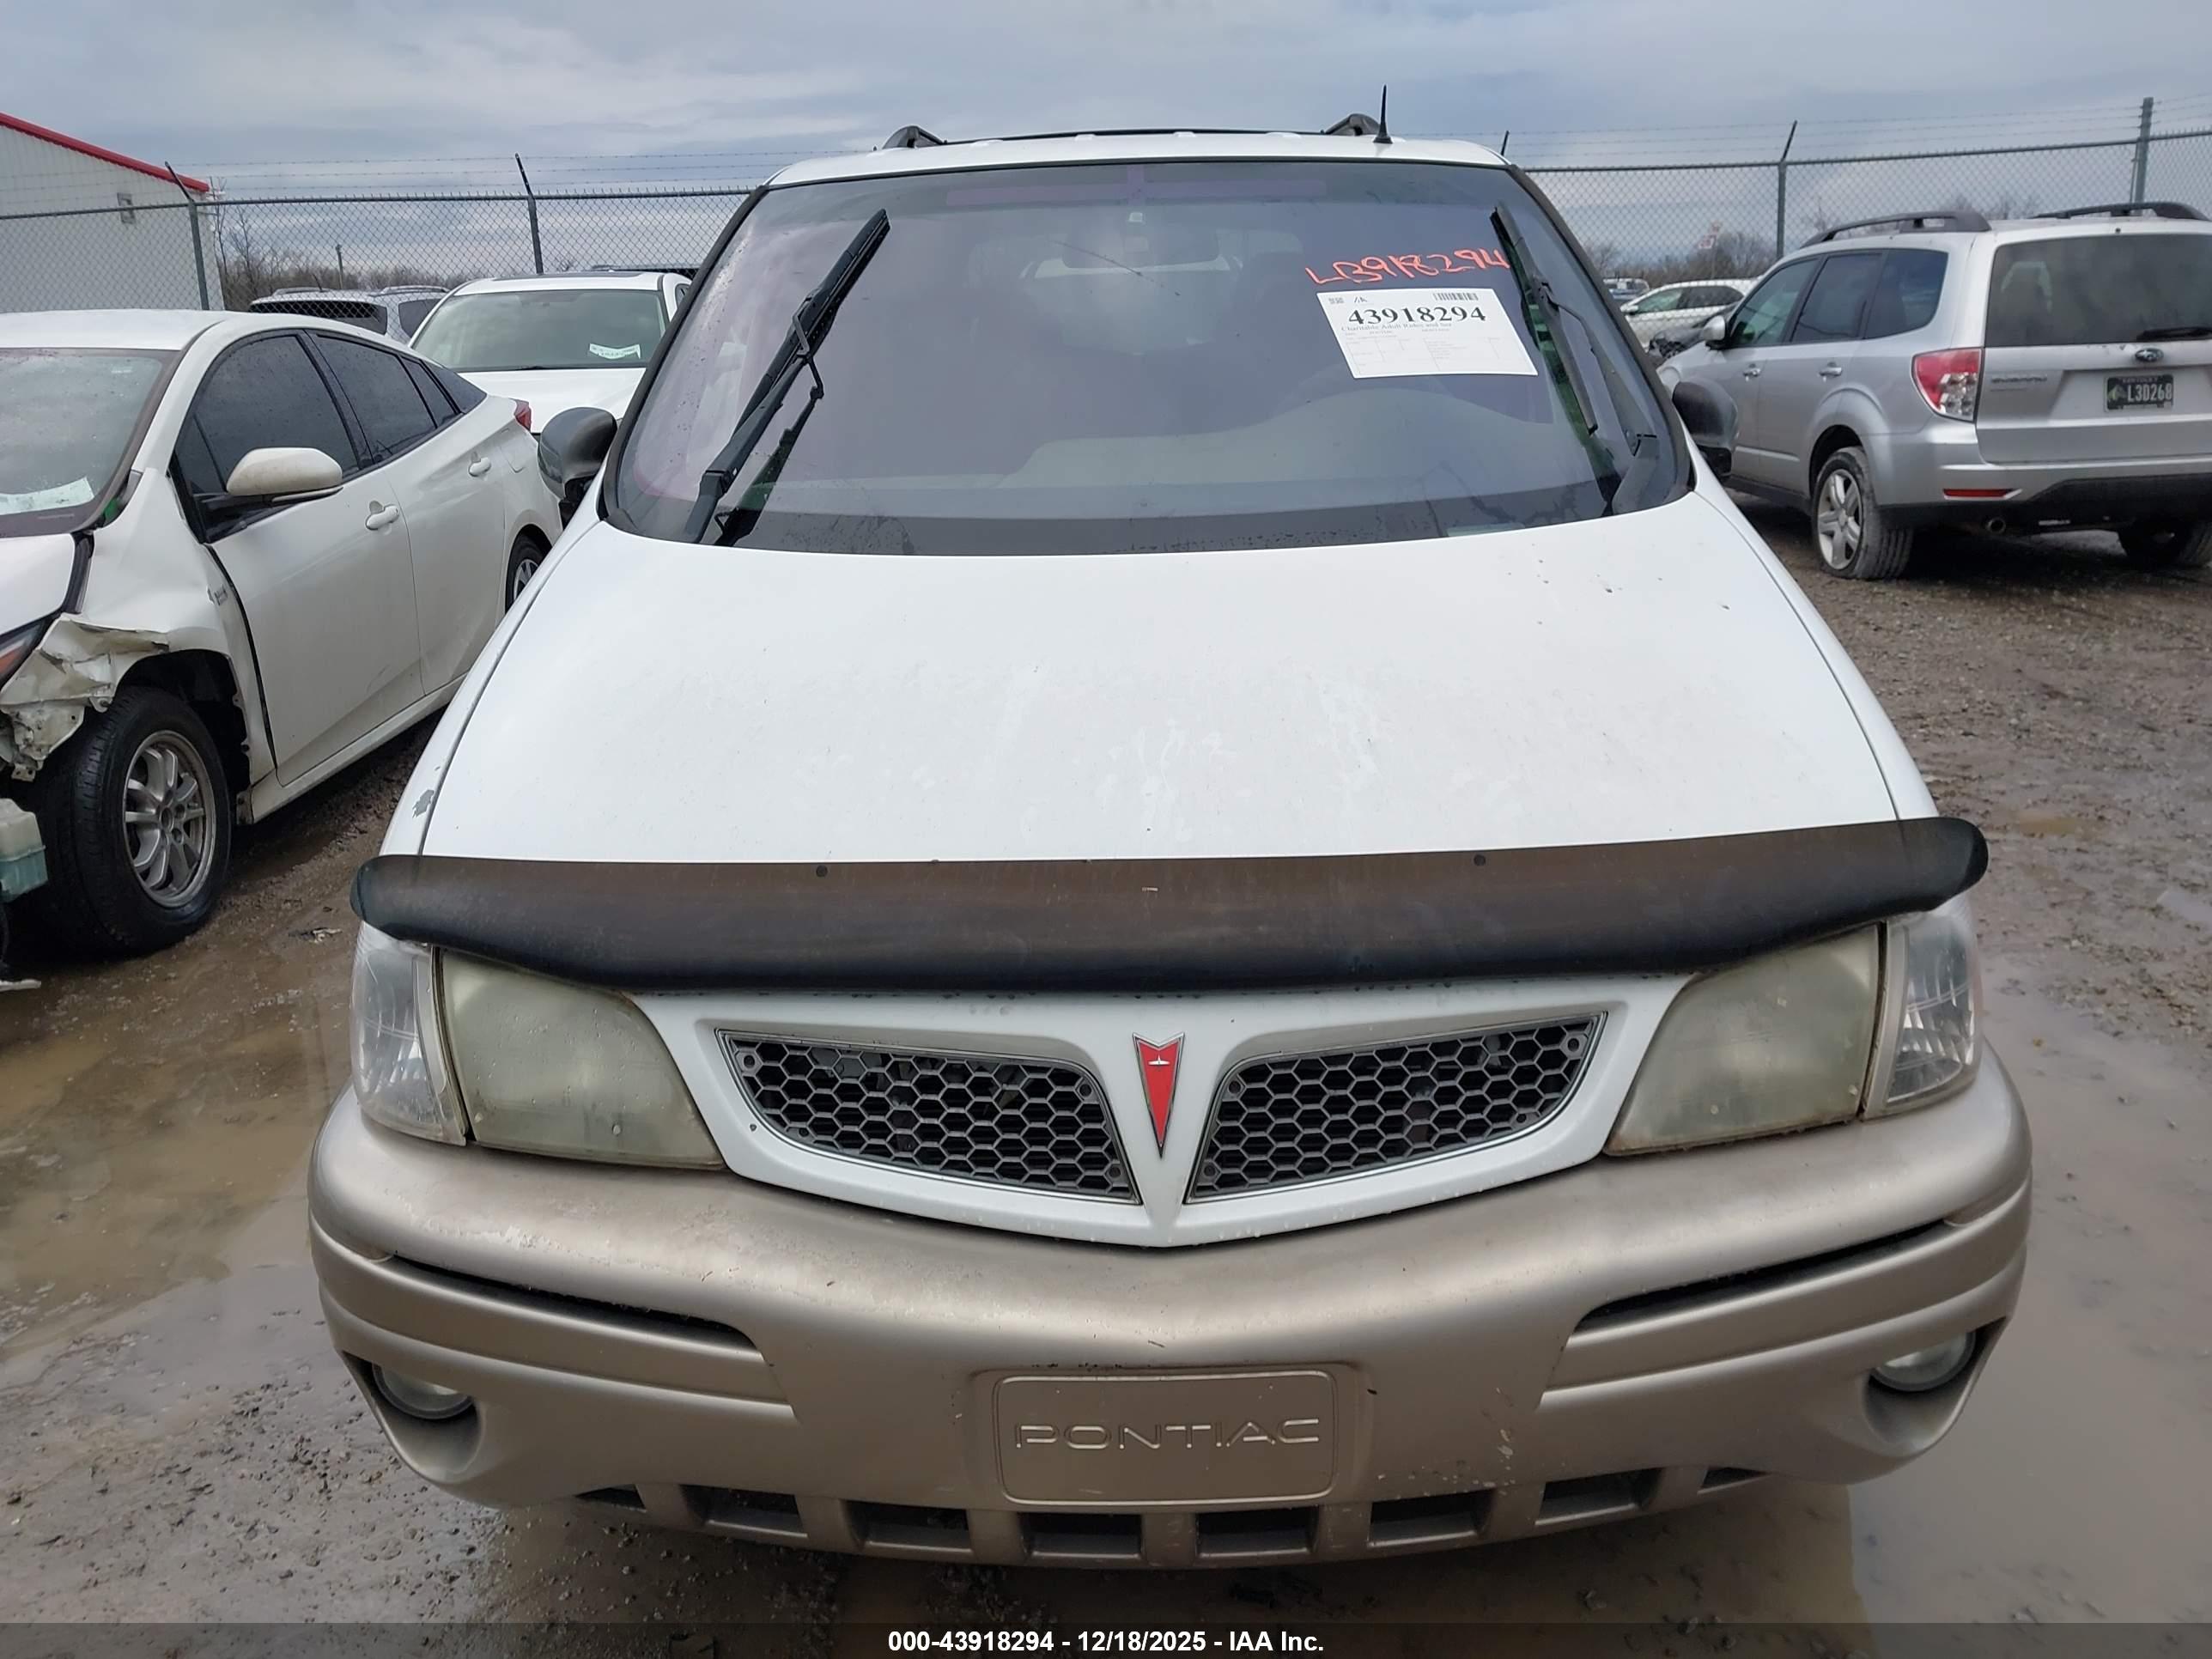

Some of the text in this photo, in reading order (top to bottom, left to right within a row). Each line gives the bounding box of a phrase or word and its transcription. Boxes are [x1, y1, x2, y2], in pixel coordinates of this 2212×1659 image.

[1348, 306, 1486, 325] 43918294
[2127, 383, 2172, 403] L3D268
[1015, 1418, 1320, 1449] PONTIAC
